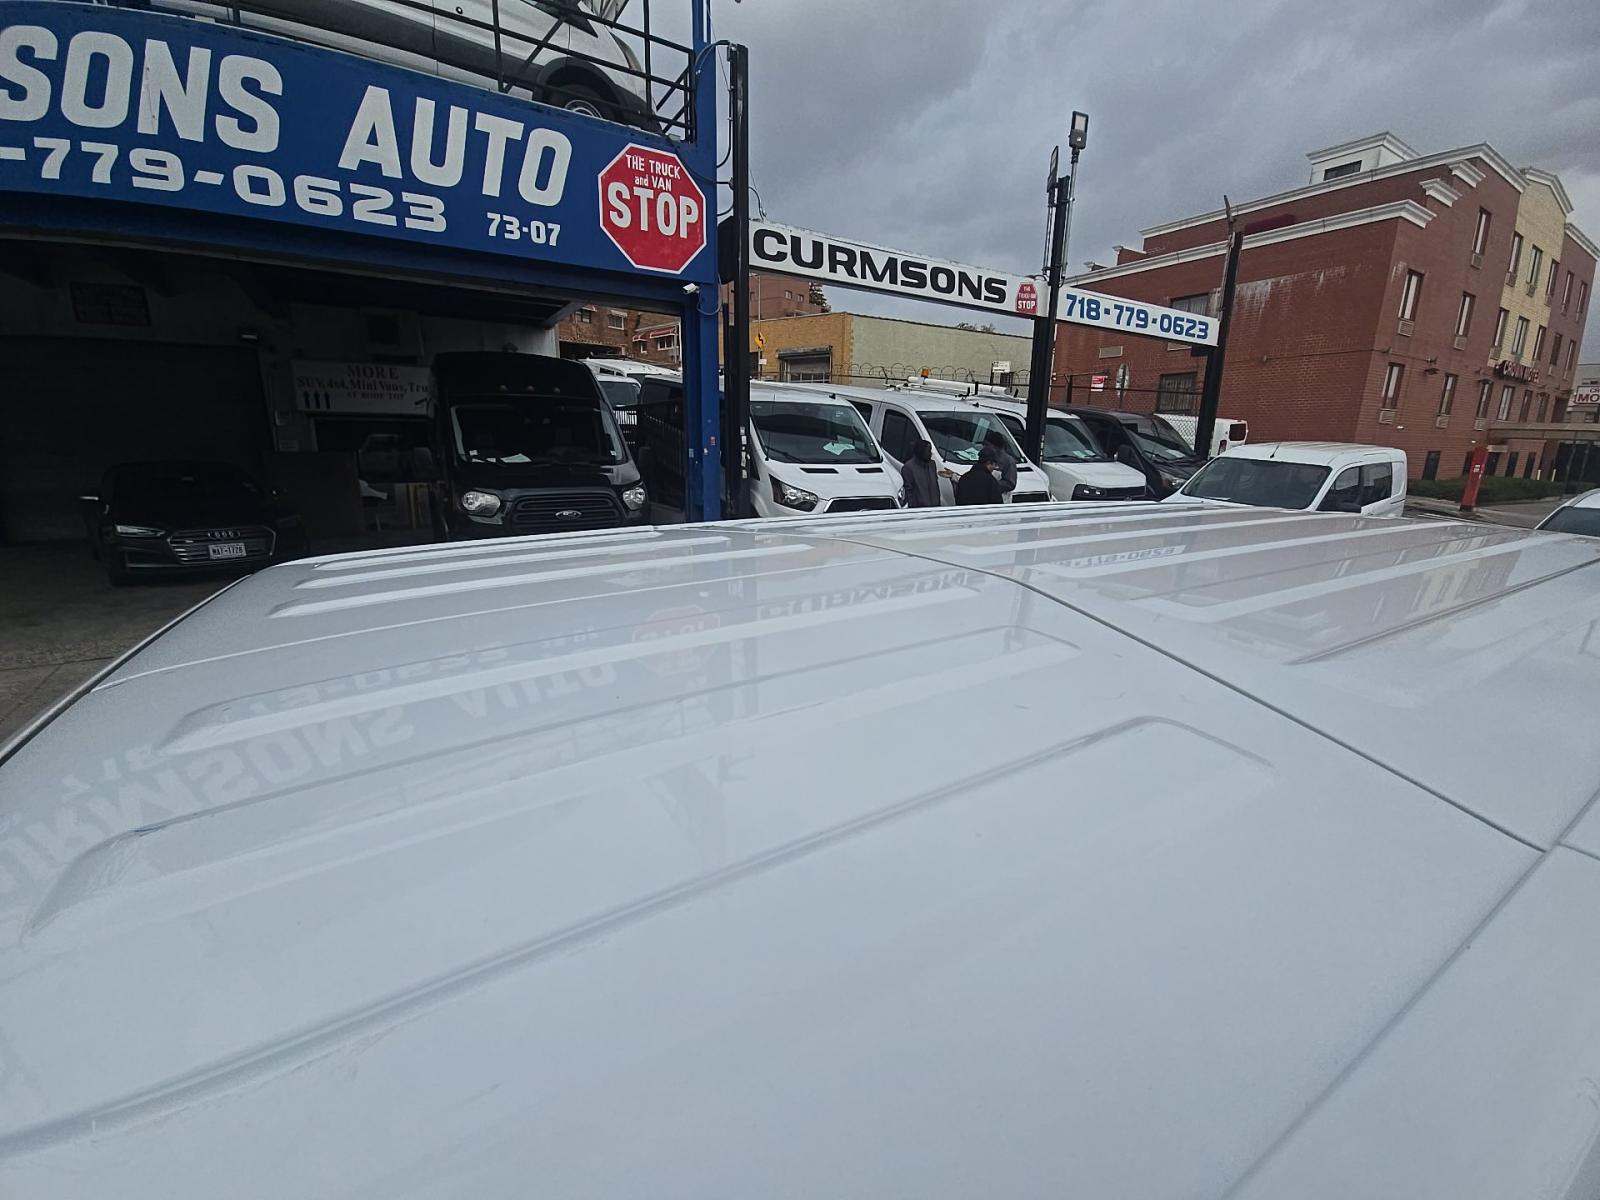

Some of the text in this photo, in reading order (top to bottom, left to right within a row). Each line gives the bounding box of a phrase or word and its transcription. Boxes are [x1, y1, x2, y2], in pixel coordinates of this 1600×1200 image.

[0, 25, 573, 207] SONS AUTO
[626, 154, 681, 180] THE TRUCK
[634, 174, 673, 192] and VAN
[607, 181, 699, 239] STOP
[487, 212, 561, 247] 73-07
[753, 228, 1008, 304] CURMSONS
[1018, 300, 1035, 309] STOP
[1066, 293, 1209, 340] 718-779-0623
[347, 364, 399, 380] MORE
